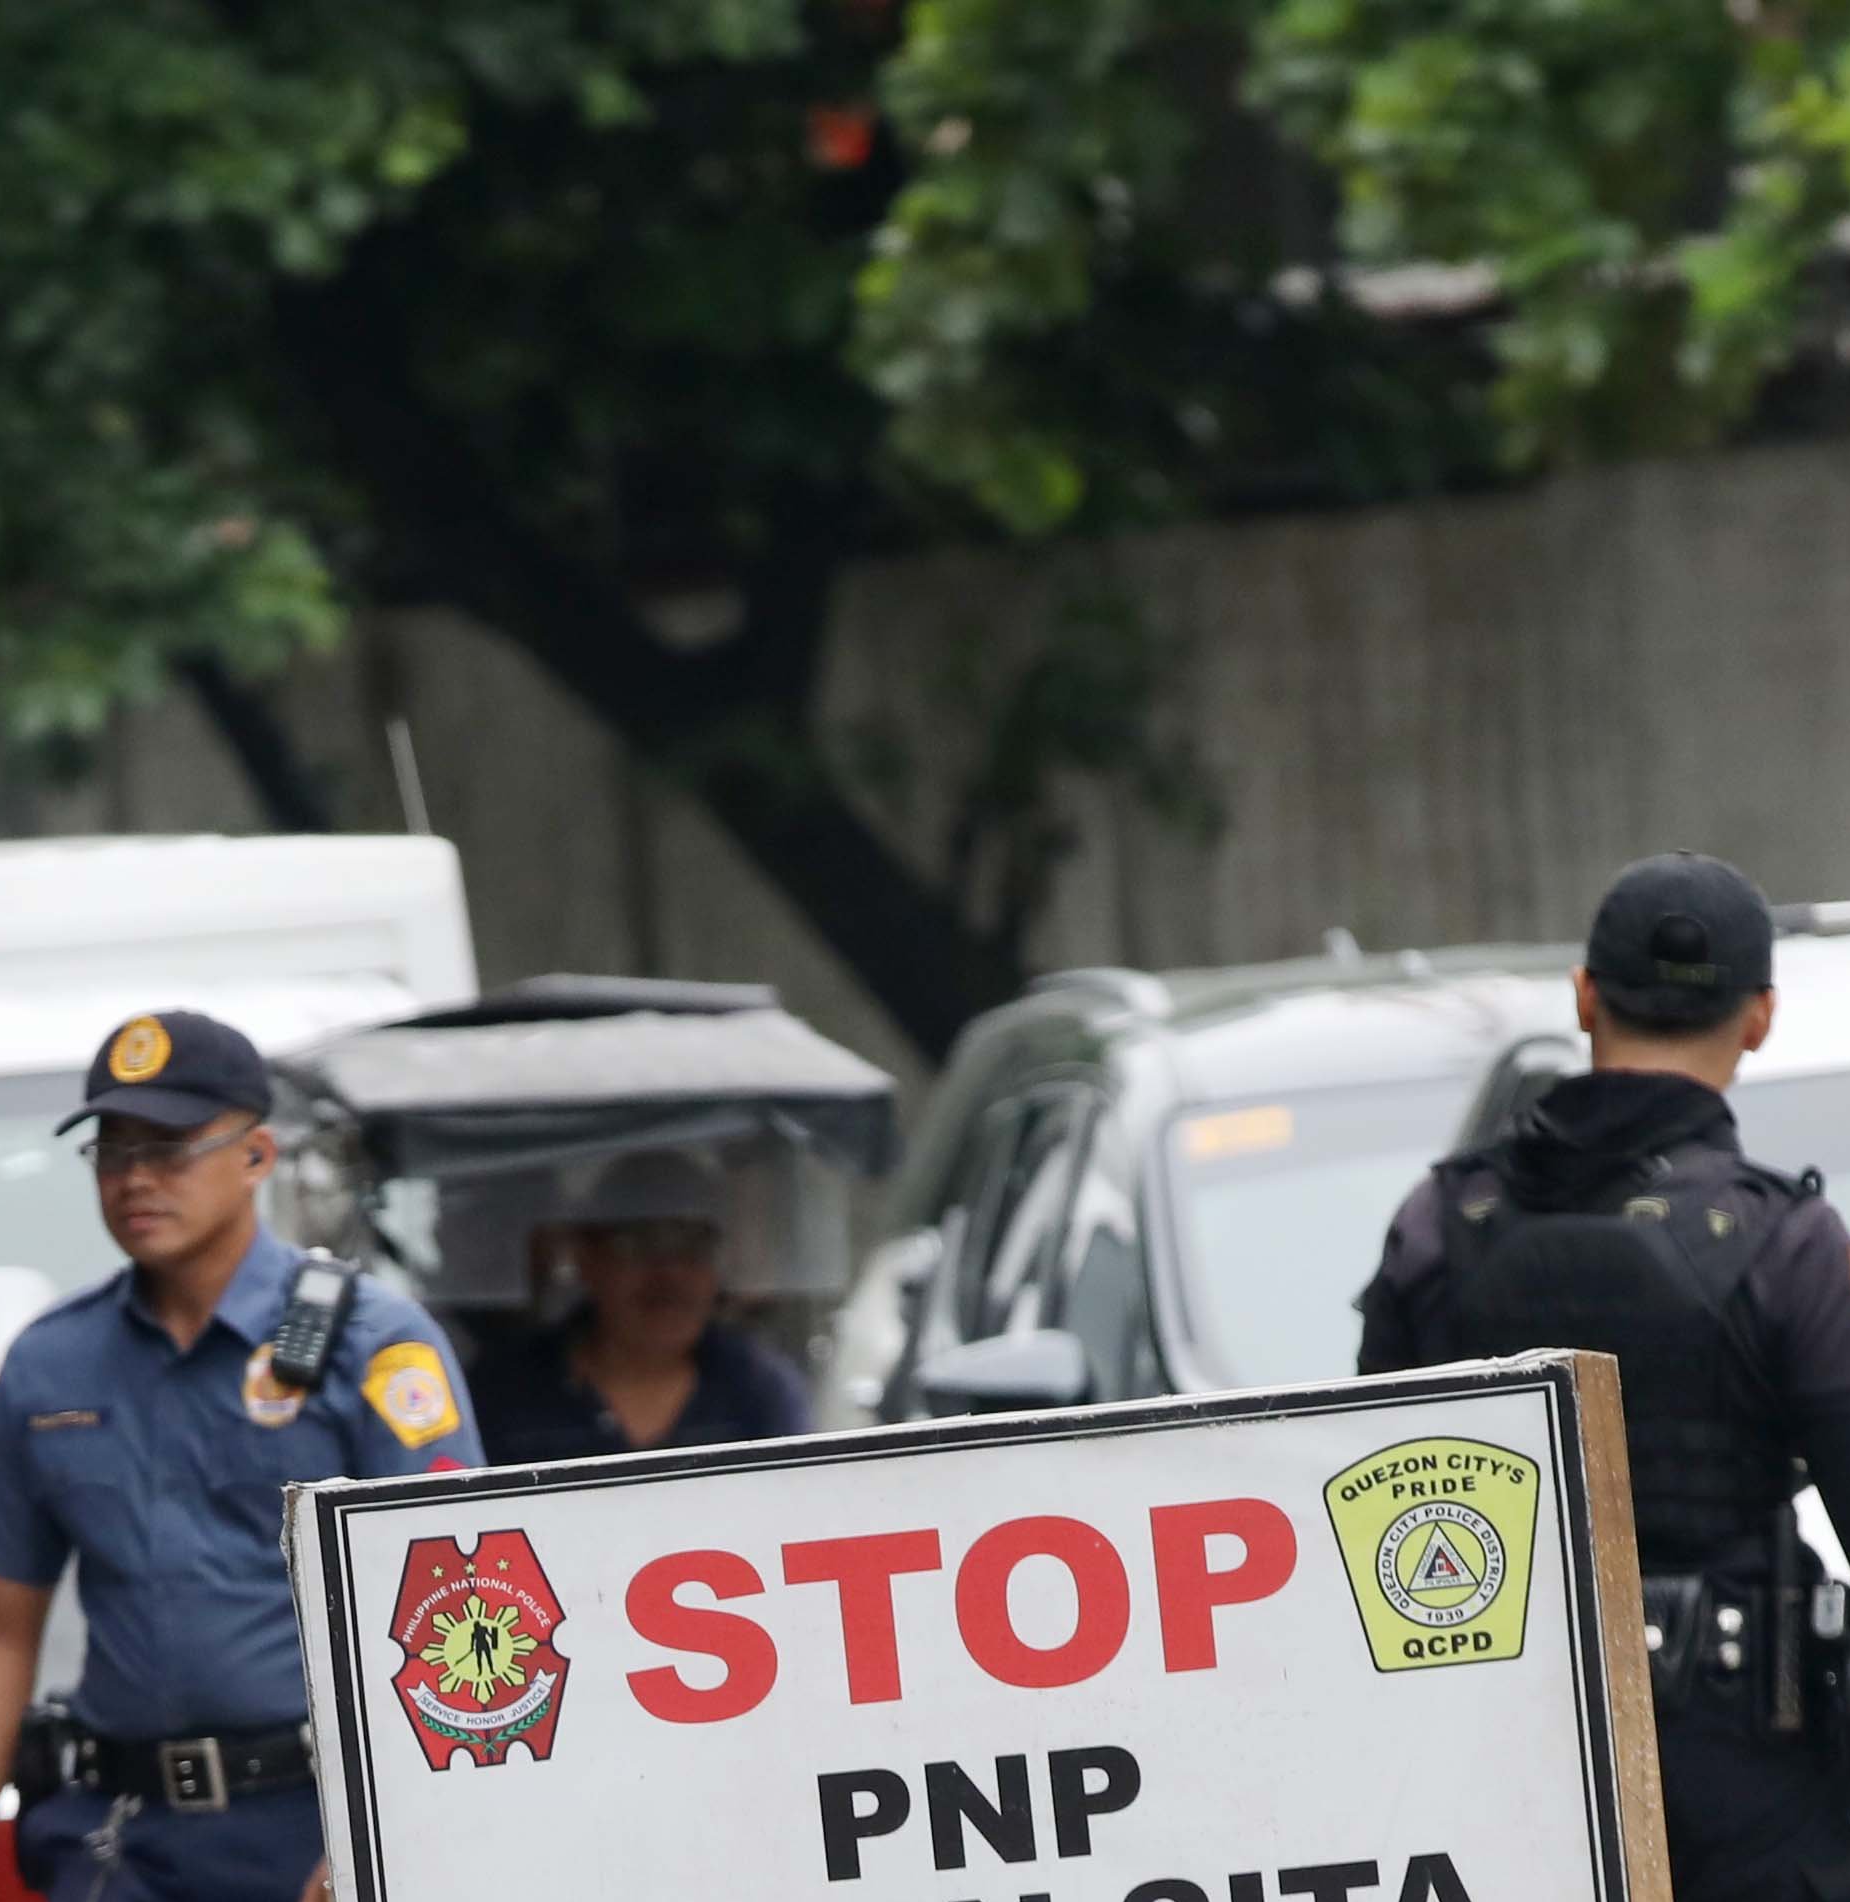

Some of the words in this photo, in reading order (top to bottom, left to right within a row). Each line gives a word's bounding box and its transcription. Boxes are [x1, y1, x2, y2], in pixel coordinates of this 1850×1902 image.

[1341, 1454, 1438, 1502] QUEZON
[1447, 1454, 1525, 1485] CITY'S
[1392, 1476, 1476, 1499] PRIDE
[1390, 1512, 1418, 1542] CITY
[1424, 1506, 1482, 1530] POLICE
[1382, 1547, 1410, 1608] QUEZON
[1480, 1530, 1500, 1602] DISTRICT
[401, 1585, 450, 1644] PHILIPPINE
[450, 1576, 515, 1596] NATIONAL
[516, 1589, 552, 1629] POLICE
[626, 1498, 1297, 1723] STOP
[1403, 1631, 1492, 1660] QCPD
[420, 1695, 461, 1724] SERVICE
[466, 1714, 506, 1726] HONOR
[511, 1686, 547, 1719] JUSTICE
[818, 1746, 1140, 1881] PNP
